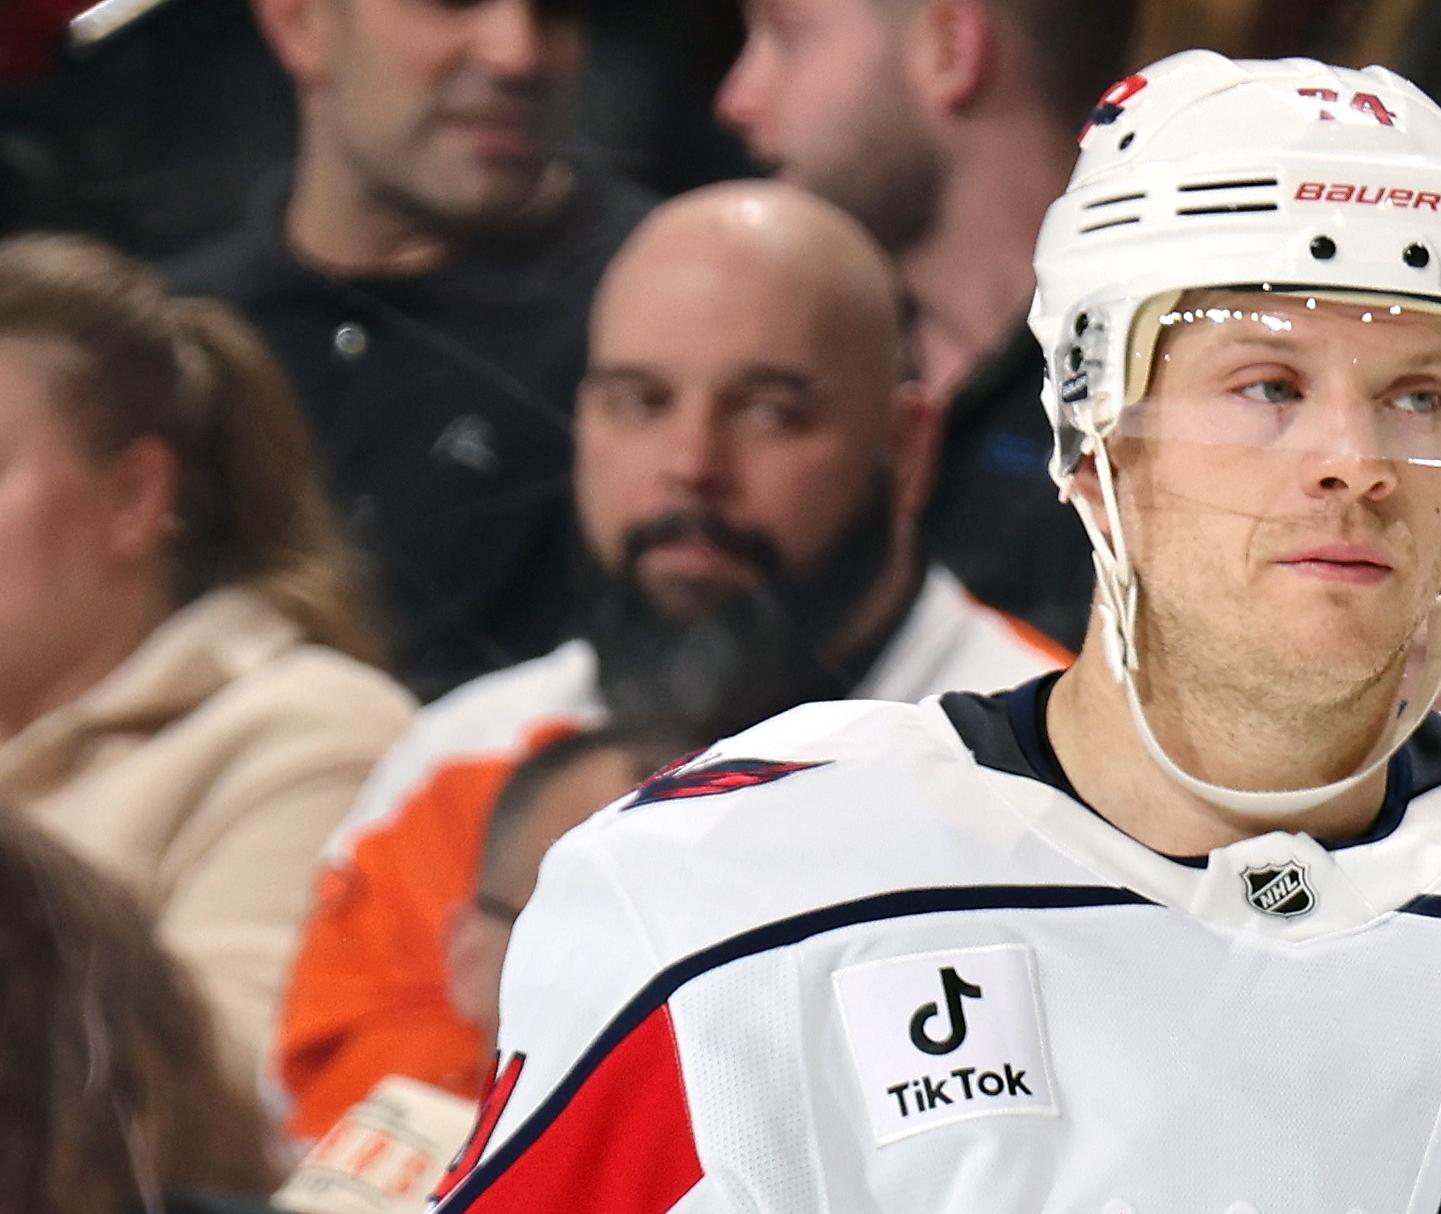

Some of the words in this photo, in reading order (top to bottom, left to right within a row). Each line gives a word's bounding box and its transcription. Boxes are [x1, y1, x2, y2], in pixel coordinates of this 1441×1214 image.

[1297, 87, 1396, 126] 74
[1295, 182, 1441, 211] BAUER
[1258, 873, 1299, 909] NHL
[887, 1063, 1033, 1118] TikTok
